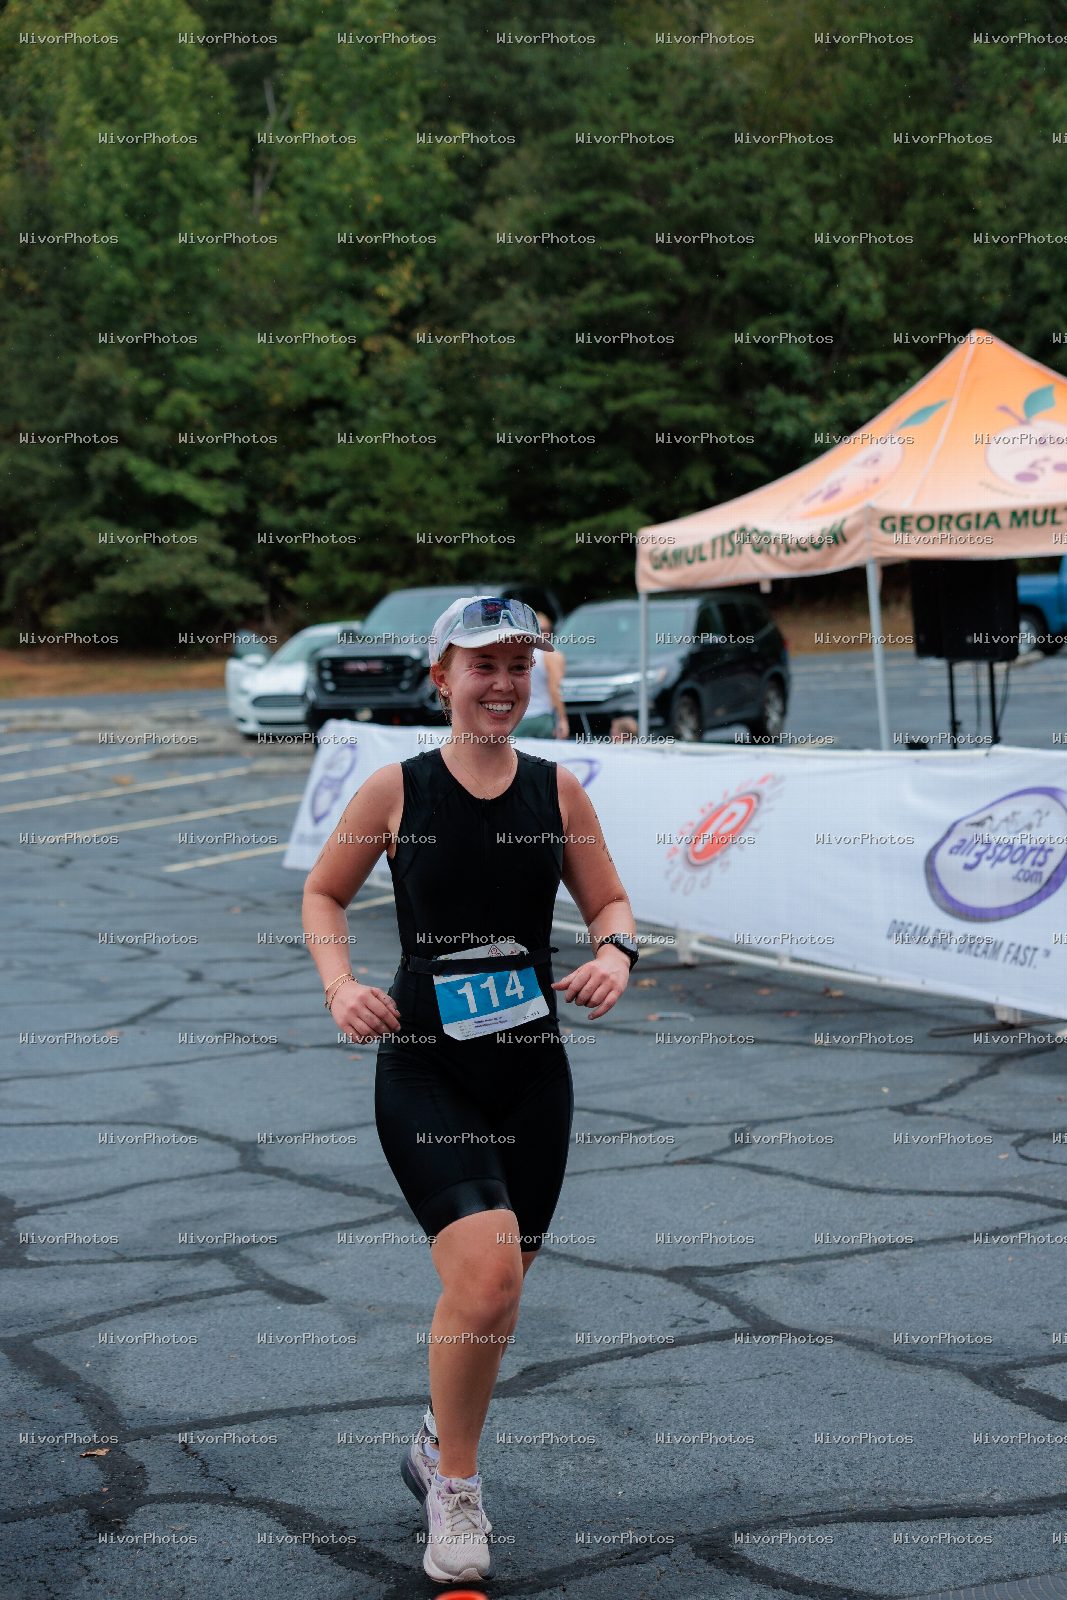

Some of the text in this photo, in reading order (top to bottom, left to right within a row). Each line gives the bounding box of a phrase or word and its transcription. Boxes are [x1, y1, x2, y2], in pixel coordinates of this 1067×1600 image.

[879, 511, 1001, 534] GEORGIA
[948, 838, 1054, 871] all3sports
[1012, 868, 1043, 884] .com
[457, 969, 525, 1014] 114
